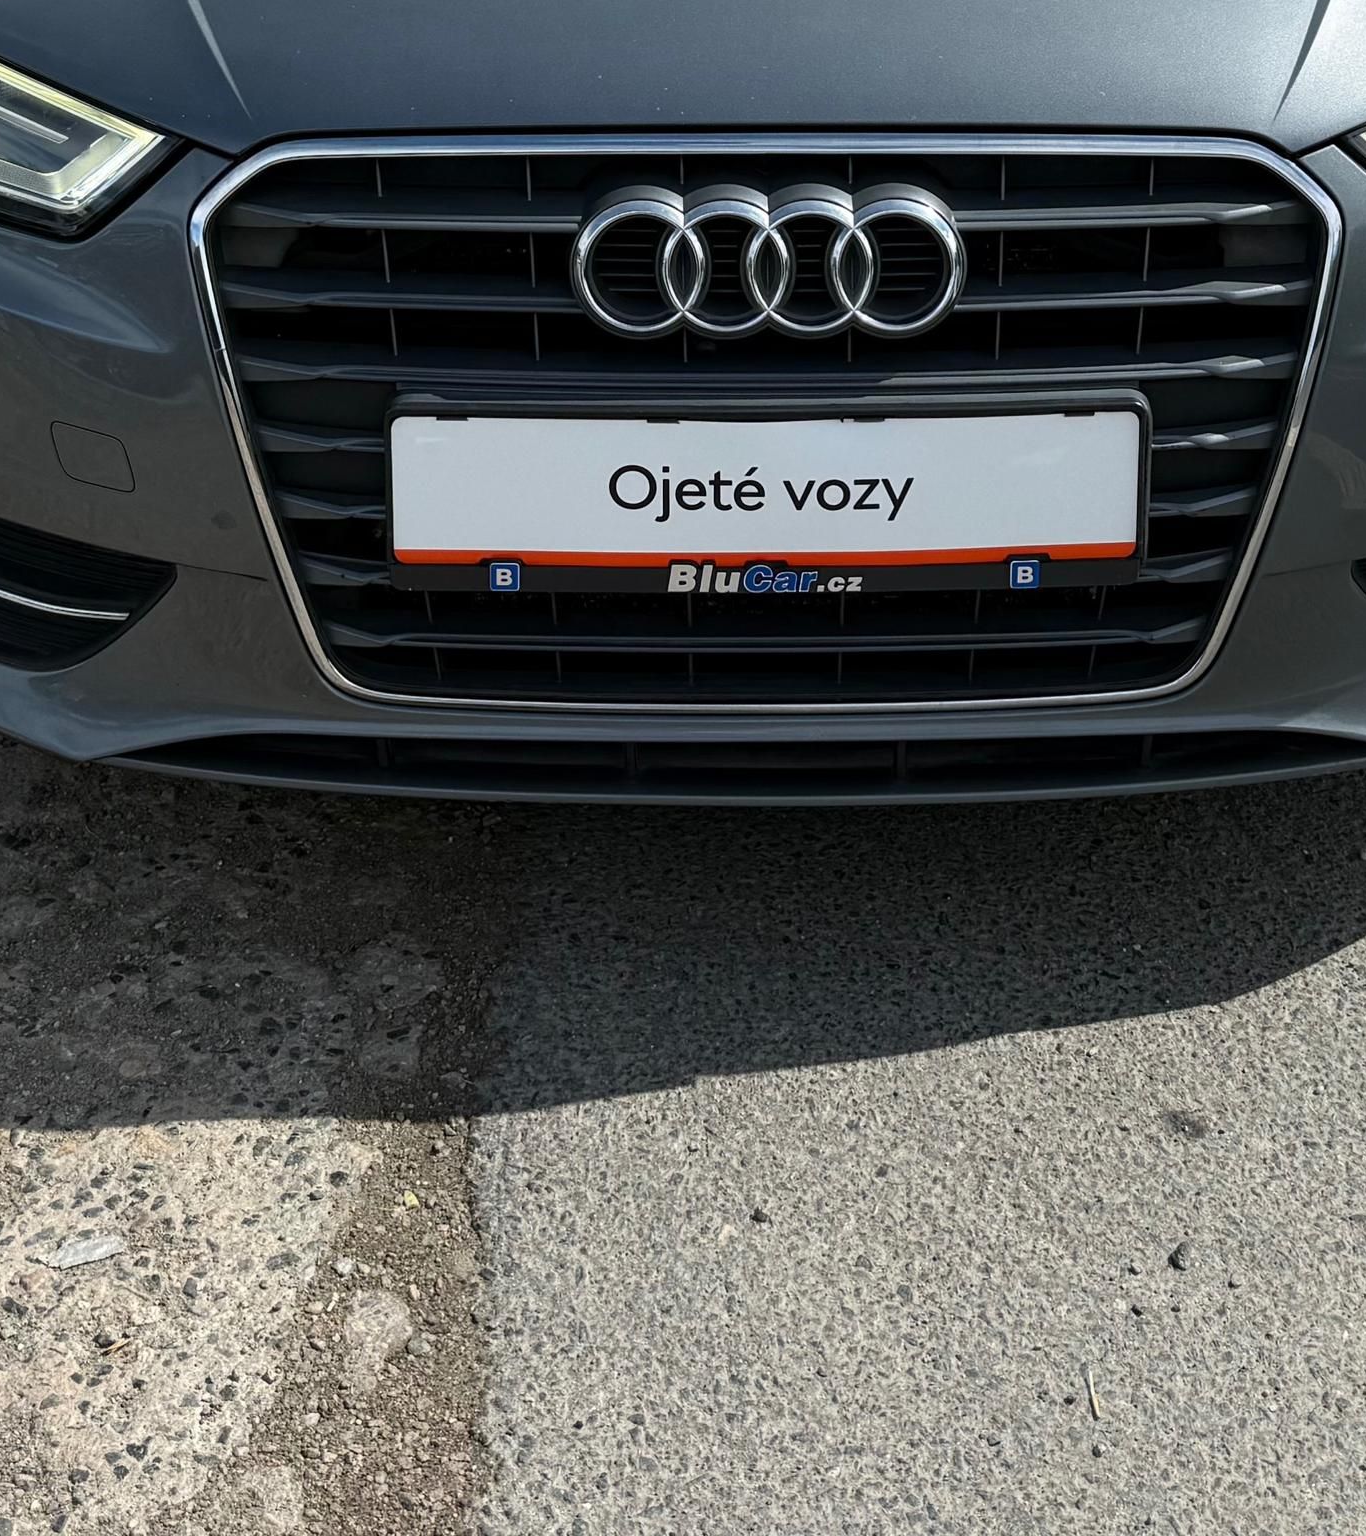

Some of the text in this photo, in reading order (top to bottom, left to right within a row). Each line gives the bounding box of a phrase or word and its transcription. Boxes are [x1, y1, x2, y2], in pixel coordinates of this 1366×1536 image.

[608, 464, 915, 523] Ojeté vozy
[496, 568, 513, 586] B
[667, 564, 863, 593] BluCar.cz
[1017, 566, 1034, 584] B
